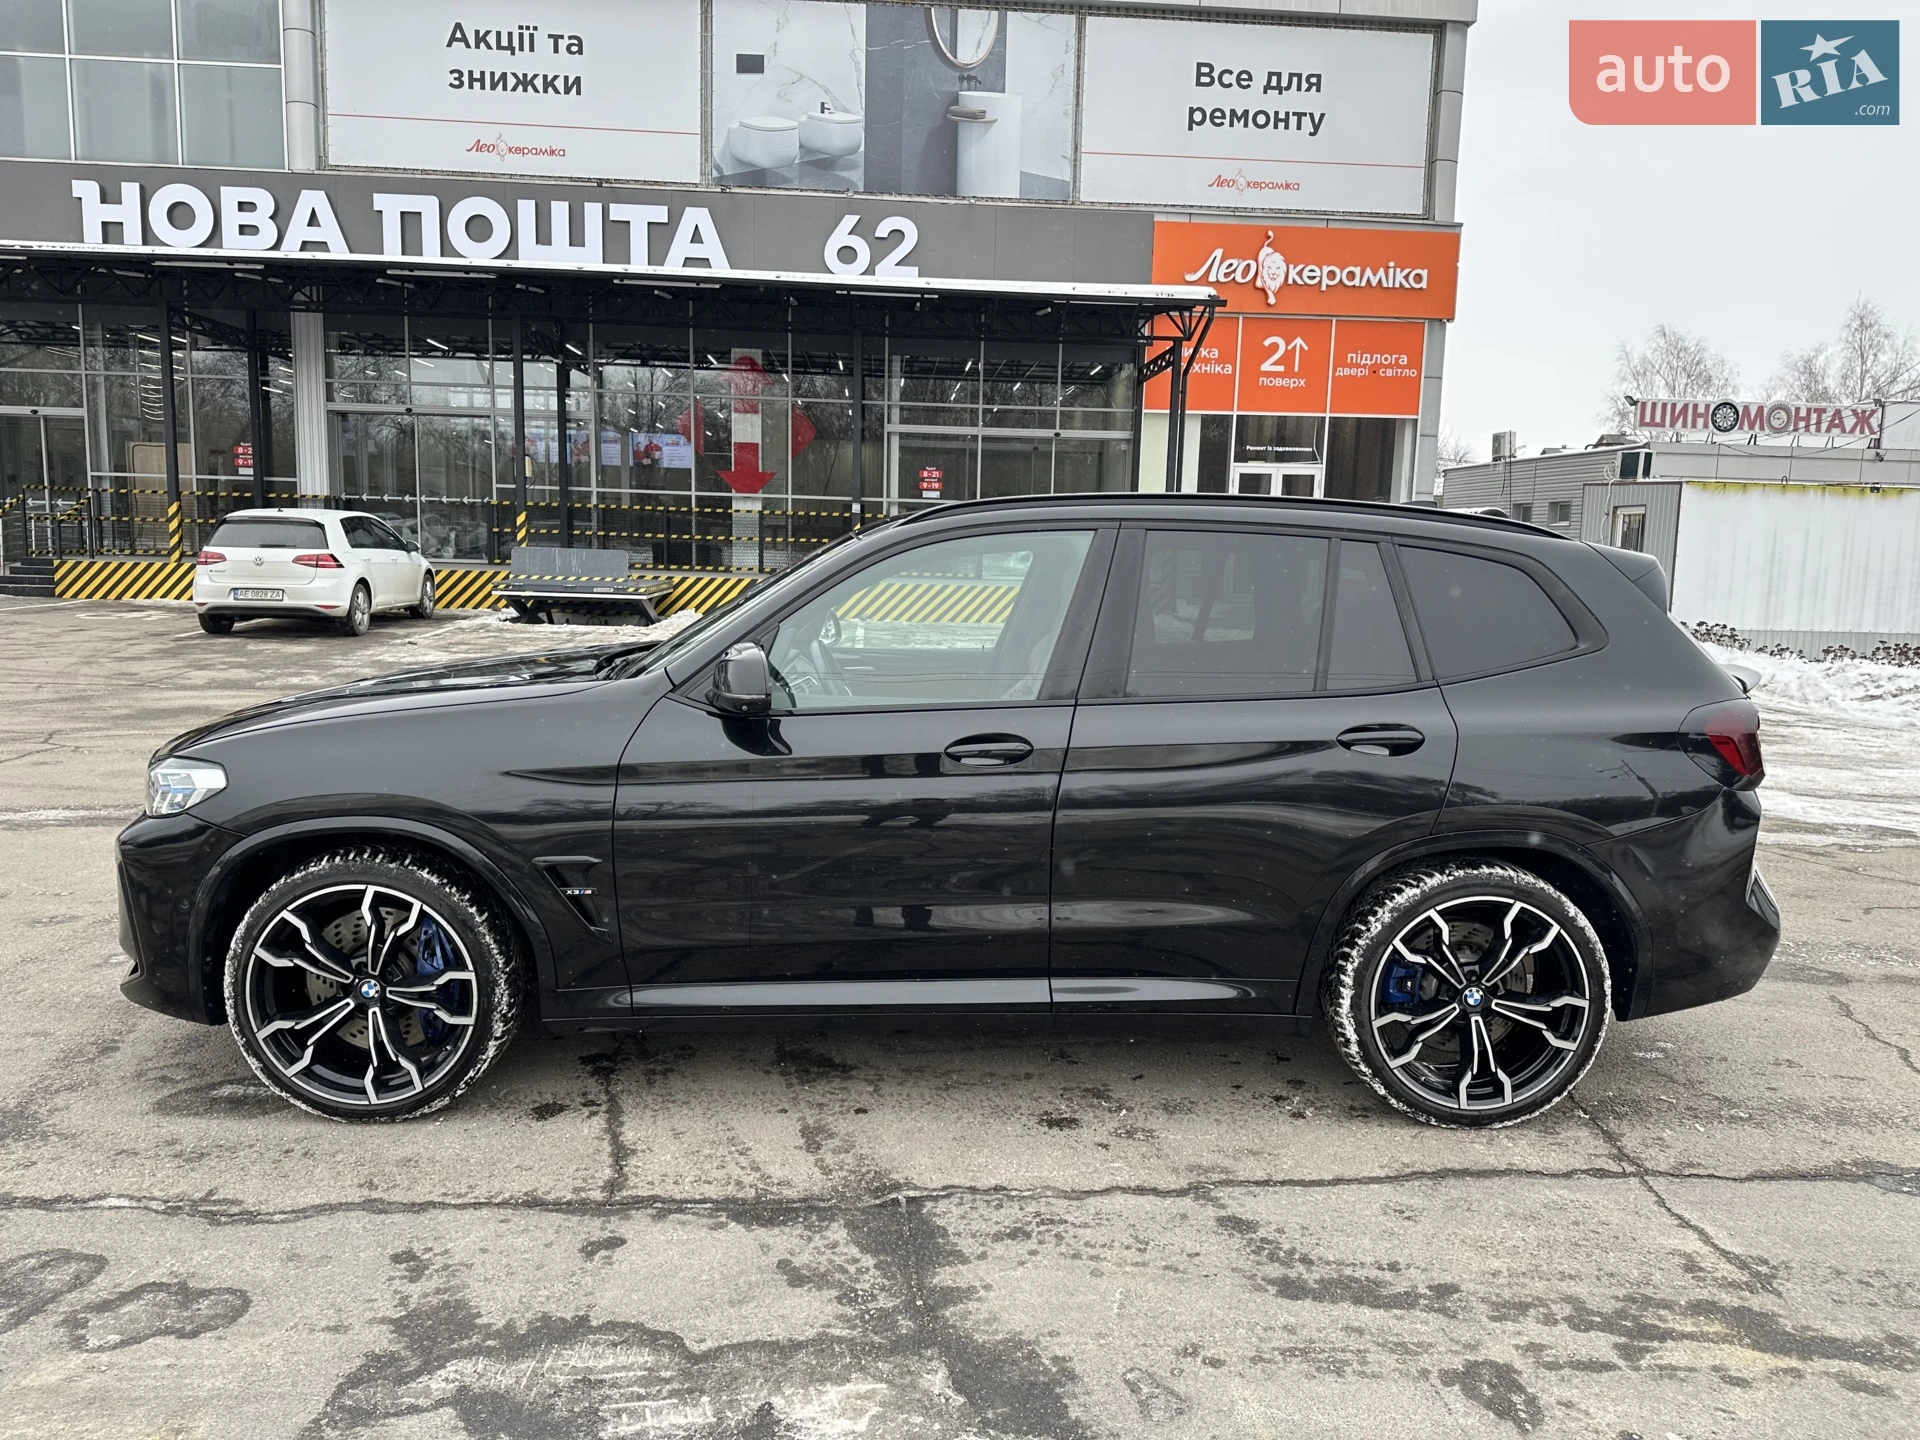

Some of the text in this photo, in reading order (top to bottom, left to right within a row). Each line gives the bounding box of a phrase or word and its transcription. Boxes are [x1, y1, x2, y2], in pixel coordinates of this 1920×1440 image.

[445, 22, 584, 56] Акції та
[448, 69, 582, 96] знижки
[1195, 62, 1322, 95] Все для
[1187, 106, 1326, 137] ремонту
[466, 139, 566, 157] Лео кераміка
[1207, 174, 1300, 191] Лео кераміка
[71, 179, 919, 278] НОВА ПОШТА 62
[1184, 248, 1429, 292] Лео кераміка
[1260, 336, 1286, 372] 2
[1346, 350, 1408, 366] підлога
[1258, 377, 1307, 389] поверх
[1335, 366, 1418, 378] двері світло
[1638, 400, 1879, 436] ШИНОМОНТАЖ
[238, 590, 250, 598] AE
[250, 590, 268, 598] 0828
[269, 590, 281, 598] ZA
